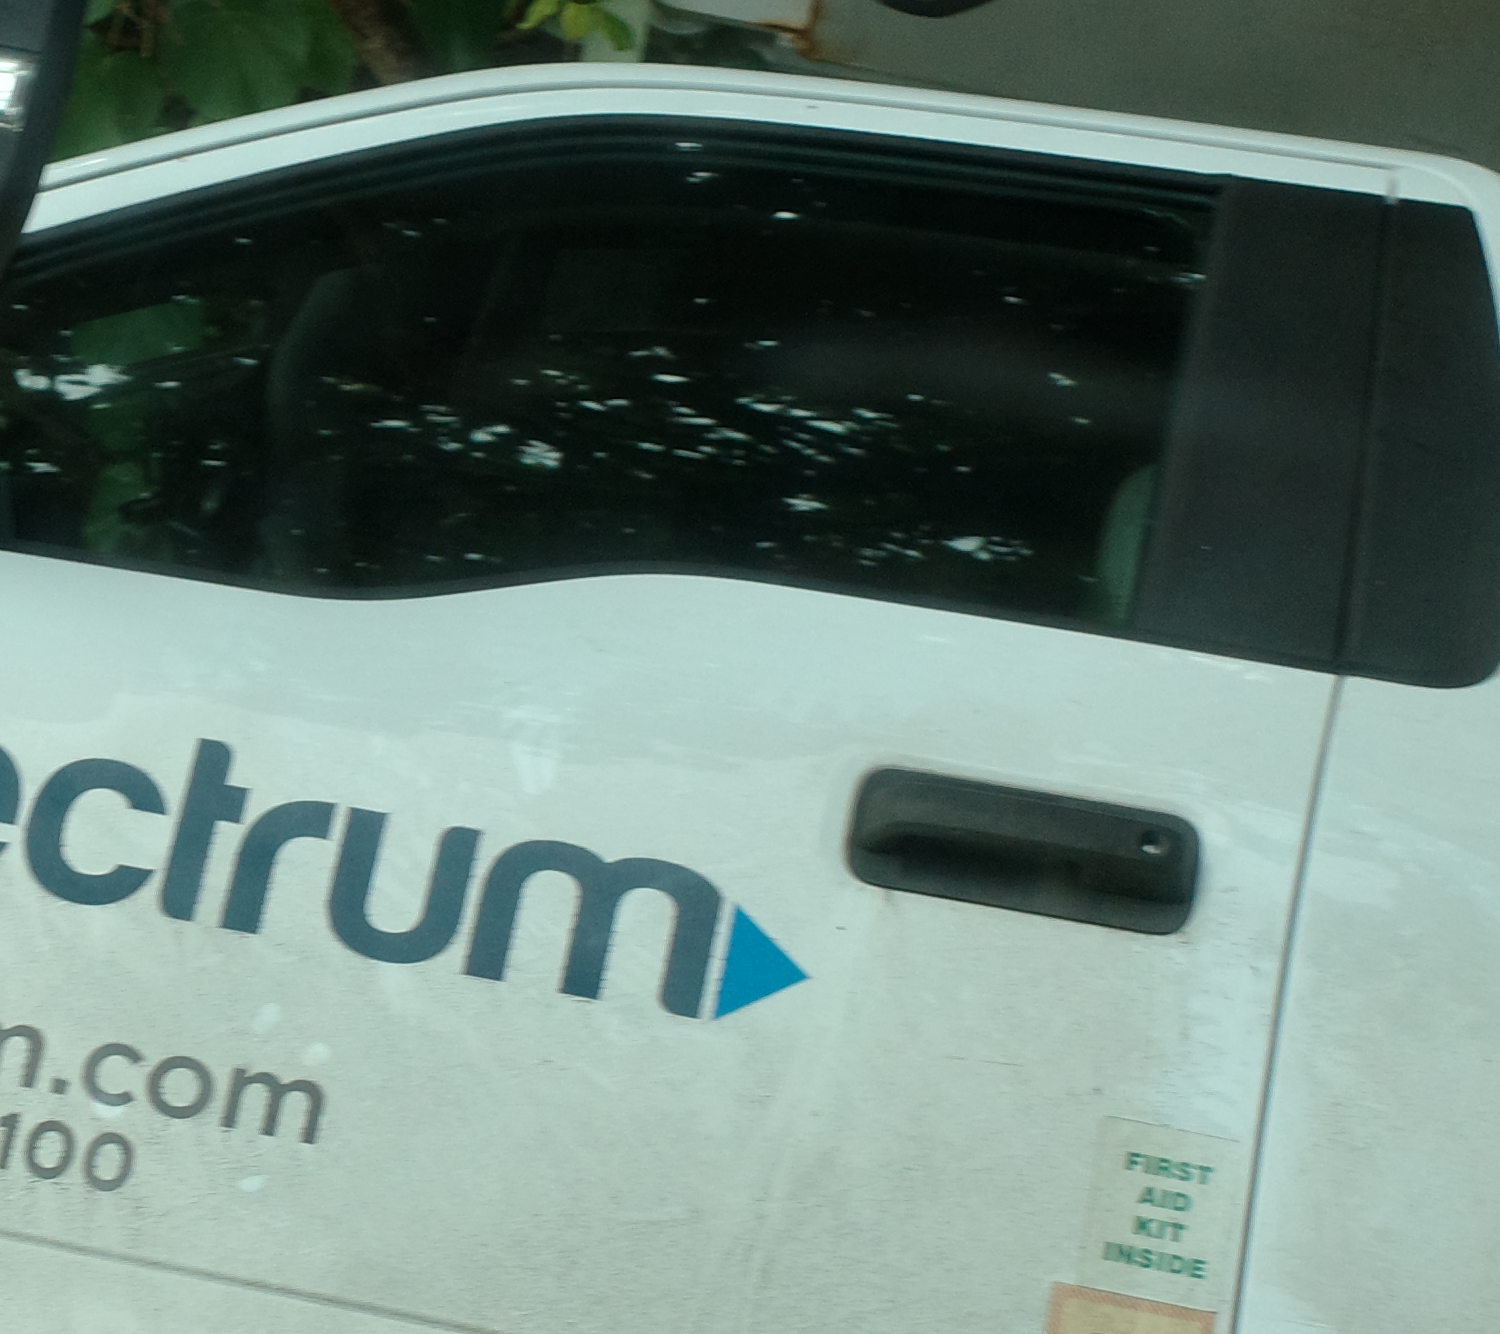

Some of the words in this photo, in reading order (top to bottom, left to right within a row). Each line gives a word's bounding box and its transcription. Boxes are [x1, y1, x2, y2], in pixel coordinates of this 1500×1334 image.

[1124, 1151, 1215, 1185] FIRST
[1137, 1186, 1194, 1212] AID
[1132, 1215, 1190, 1242] KIT
[1102, 1241, 1208, 1280] INSIDE
